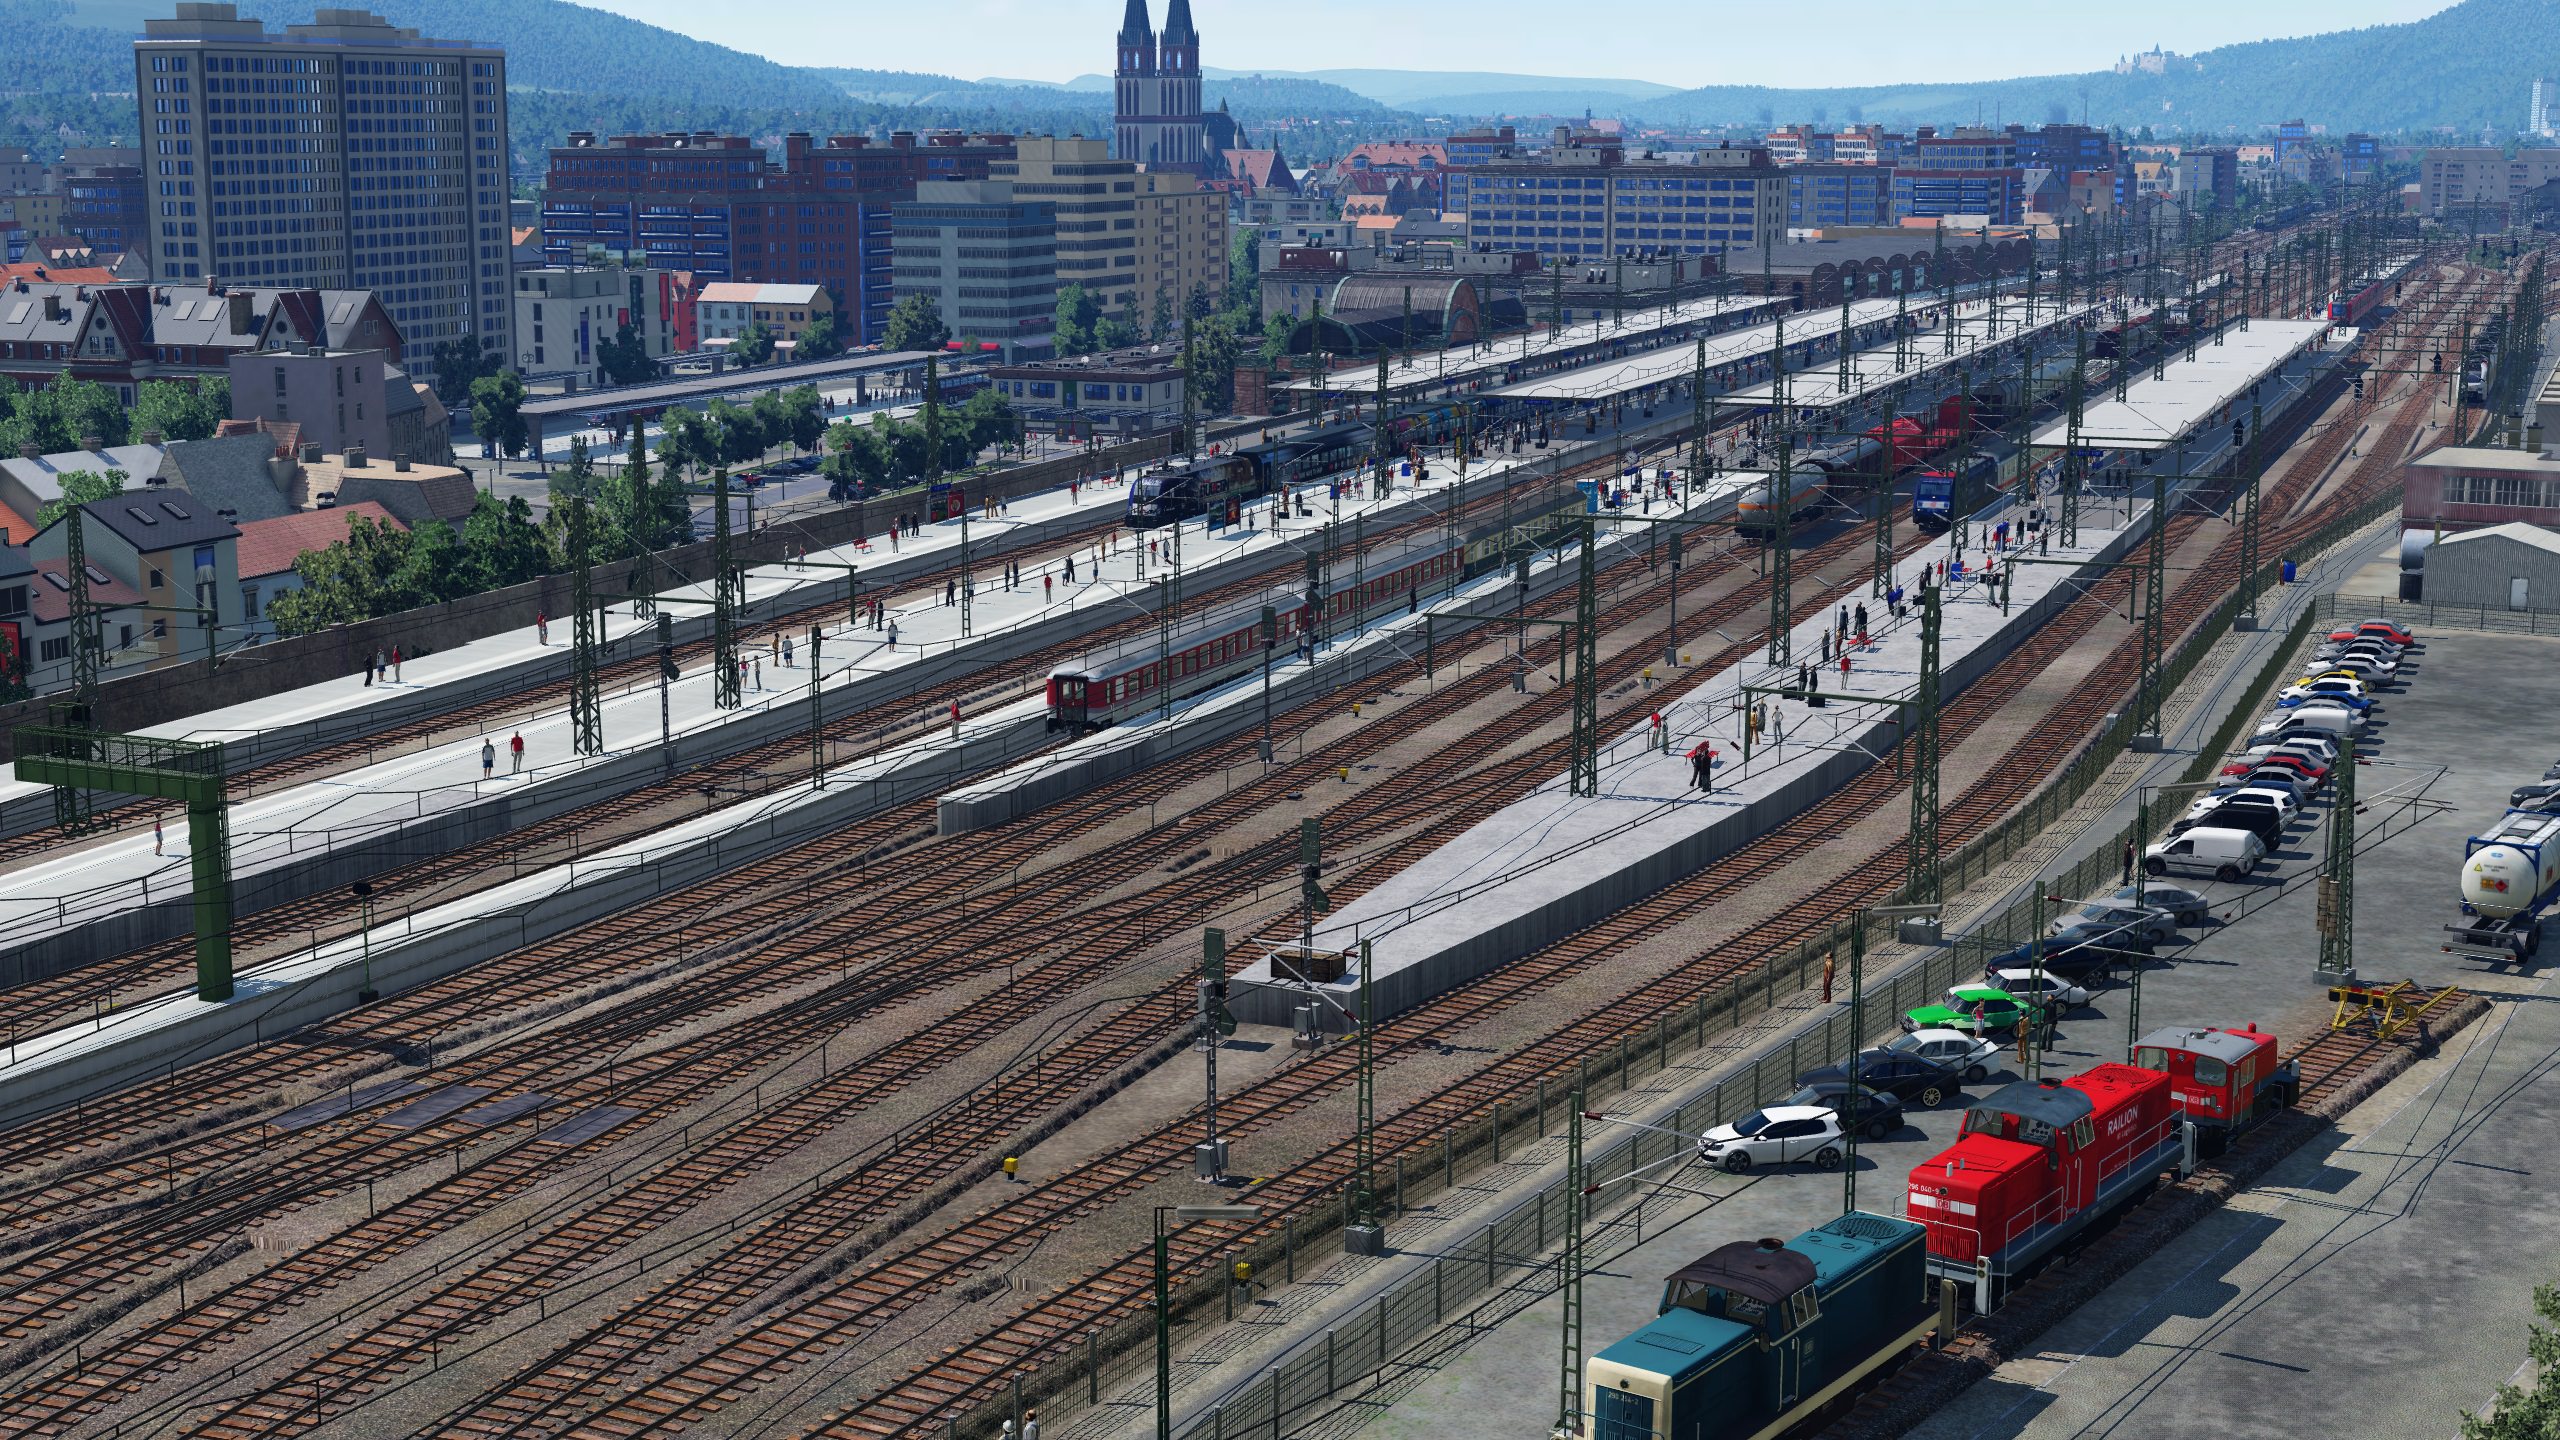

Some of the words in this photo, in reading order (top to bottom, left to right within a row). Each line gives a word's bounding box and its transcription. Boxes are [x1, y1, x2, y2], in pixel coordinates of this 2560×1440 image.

[2107, 1104, 2139, 1136] RAILION
[1908, 1182, 1919, 1191] 296
[1920, 1185, 1939, 1194] 040-9
[1937, 1199, 1949, 1209] DB
